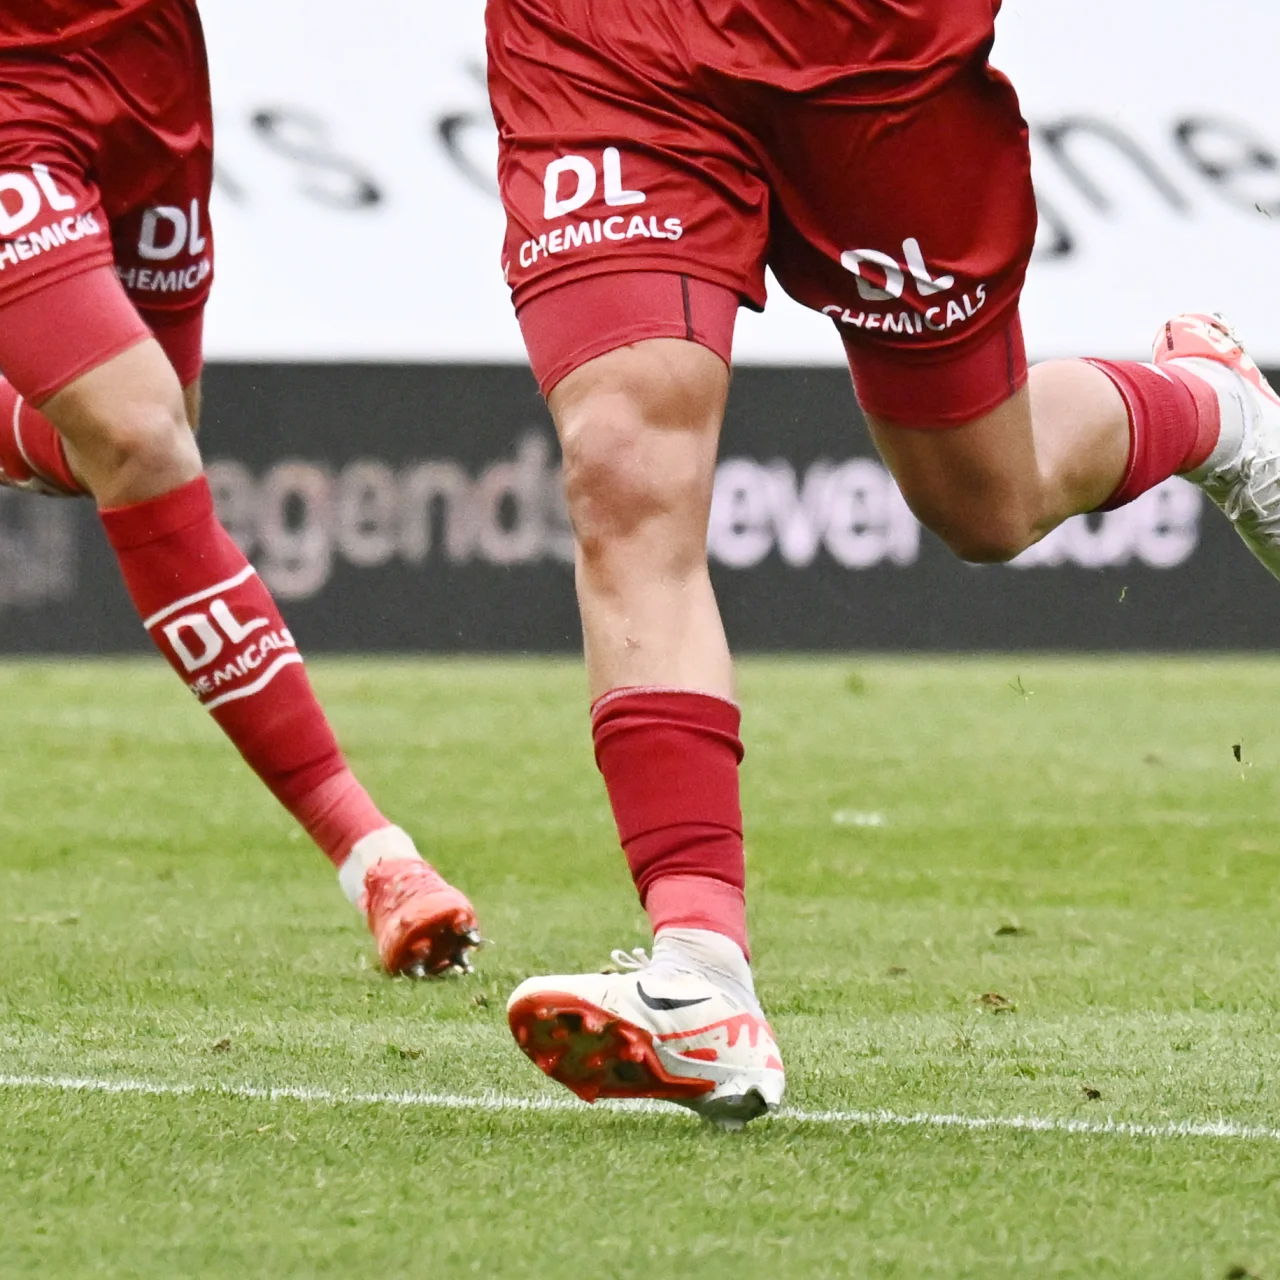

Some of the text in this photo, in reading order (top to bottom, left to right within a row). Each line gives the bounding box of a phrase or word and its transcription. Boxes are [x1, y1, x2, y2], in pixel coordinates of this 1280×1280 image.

[543, 146, 647, 220] DL
[138, 197, 206, 261] DL
[519, 215, 683, 268] CHEMICALS
[840, 237, 954, 301] DL
[162, 598, 270, 674] DL
